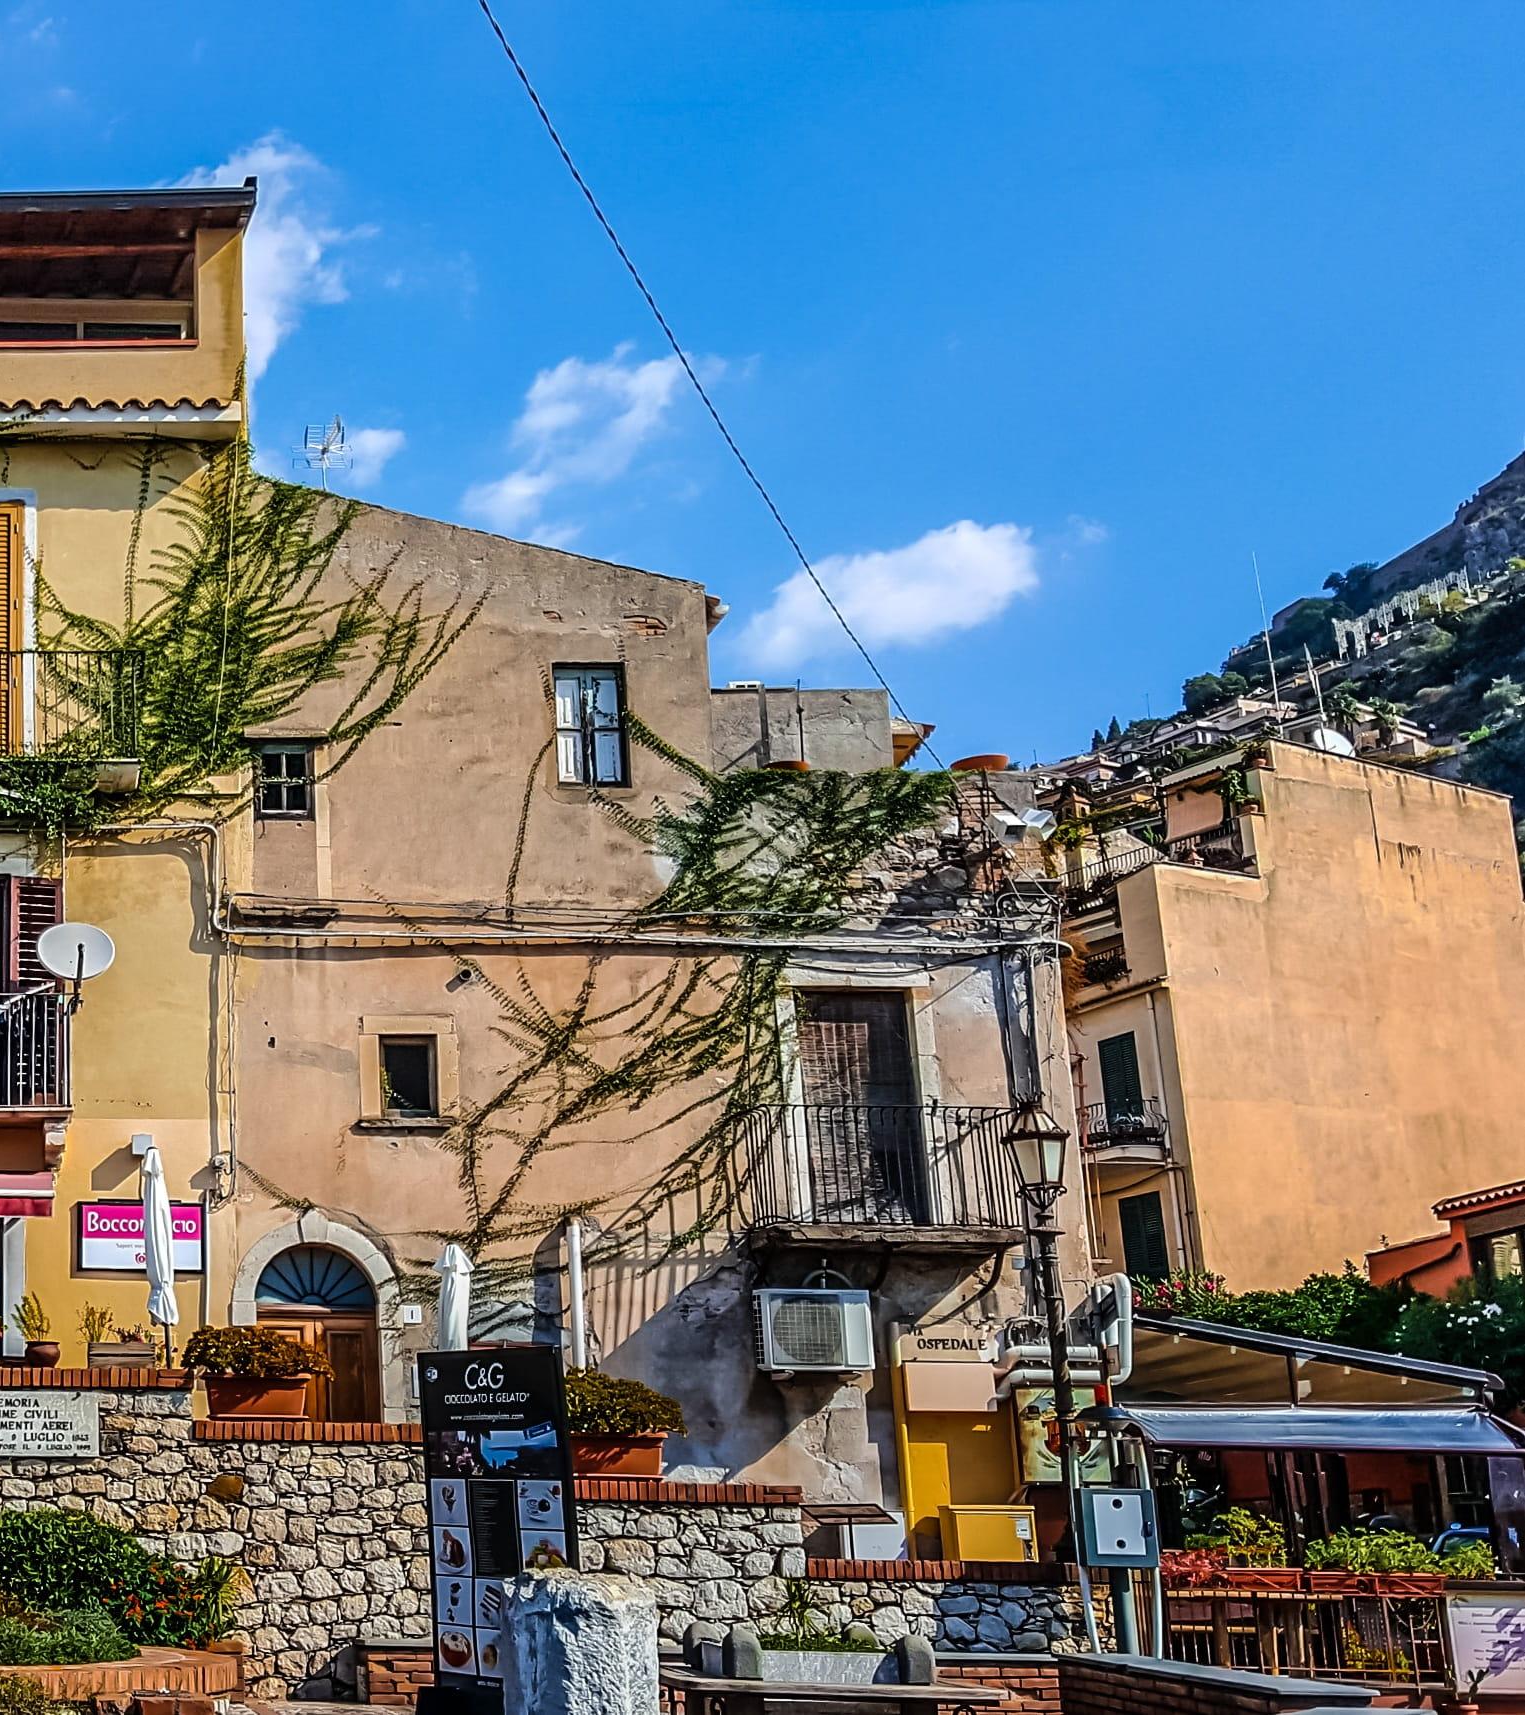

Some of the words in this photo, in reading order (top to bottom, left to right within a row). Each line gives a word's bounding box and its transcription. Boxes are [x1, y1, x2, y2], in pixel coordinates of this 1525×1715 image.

[917, 1338, 988, 1351] OSPEDALE
[464, 1362, 505, 1390] C&G
[24, 1409, 58, 1419] CIVILI
[41, 1421, 73, 1431] AEREI
[24, 1432, 65, 1442] LUGLIO
